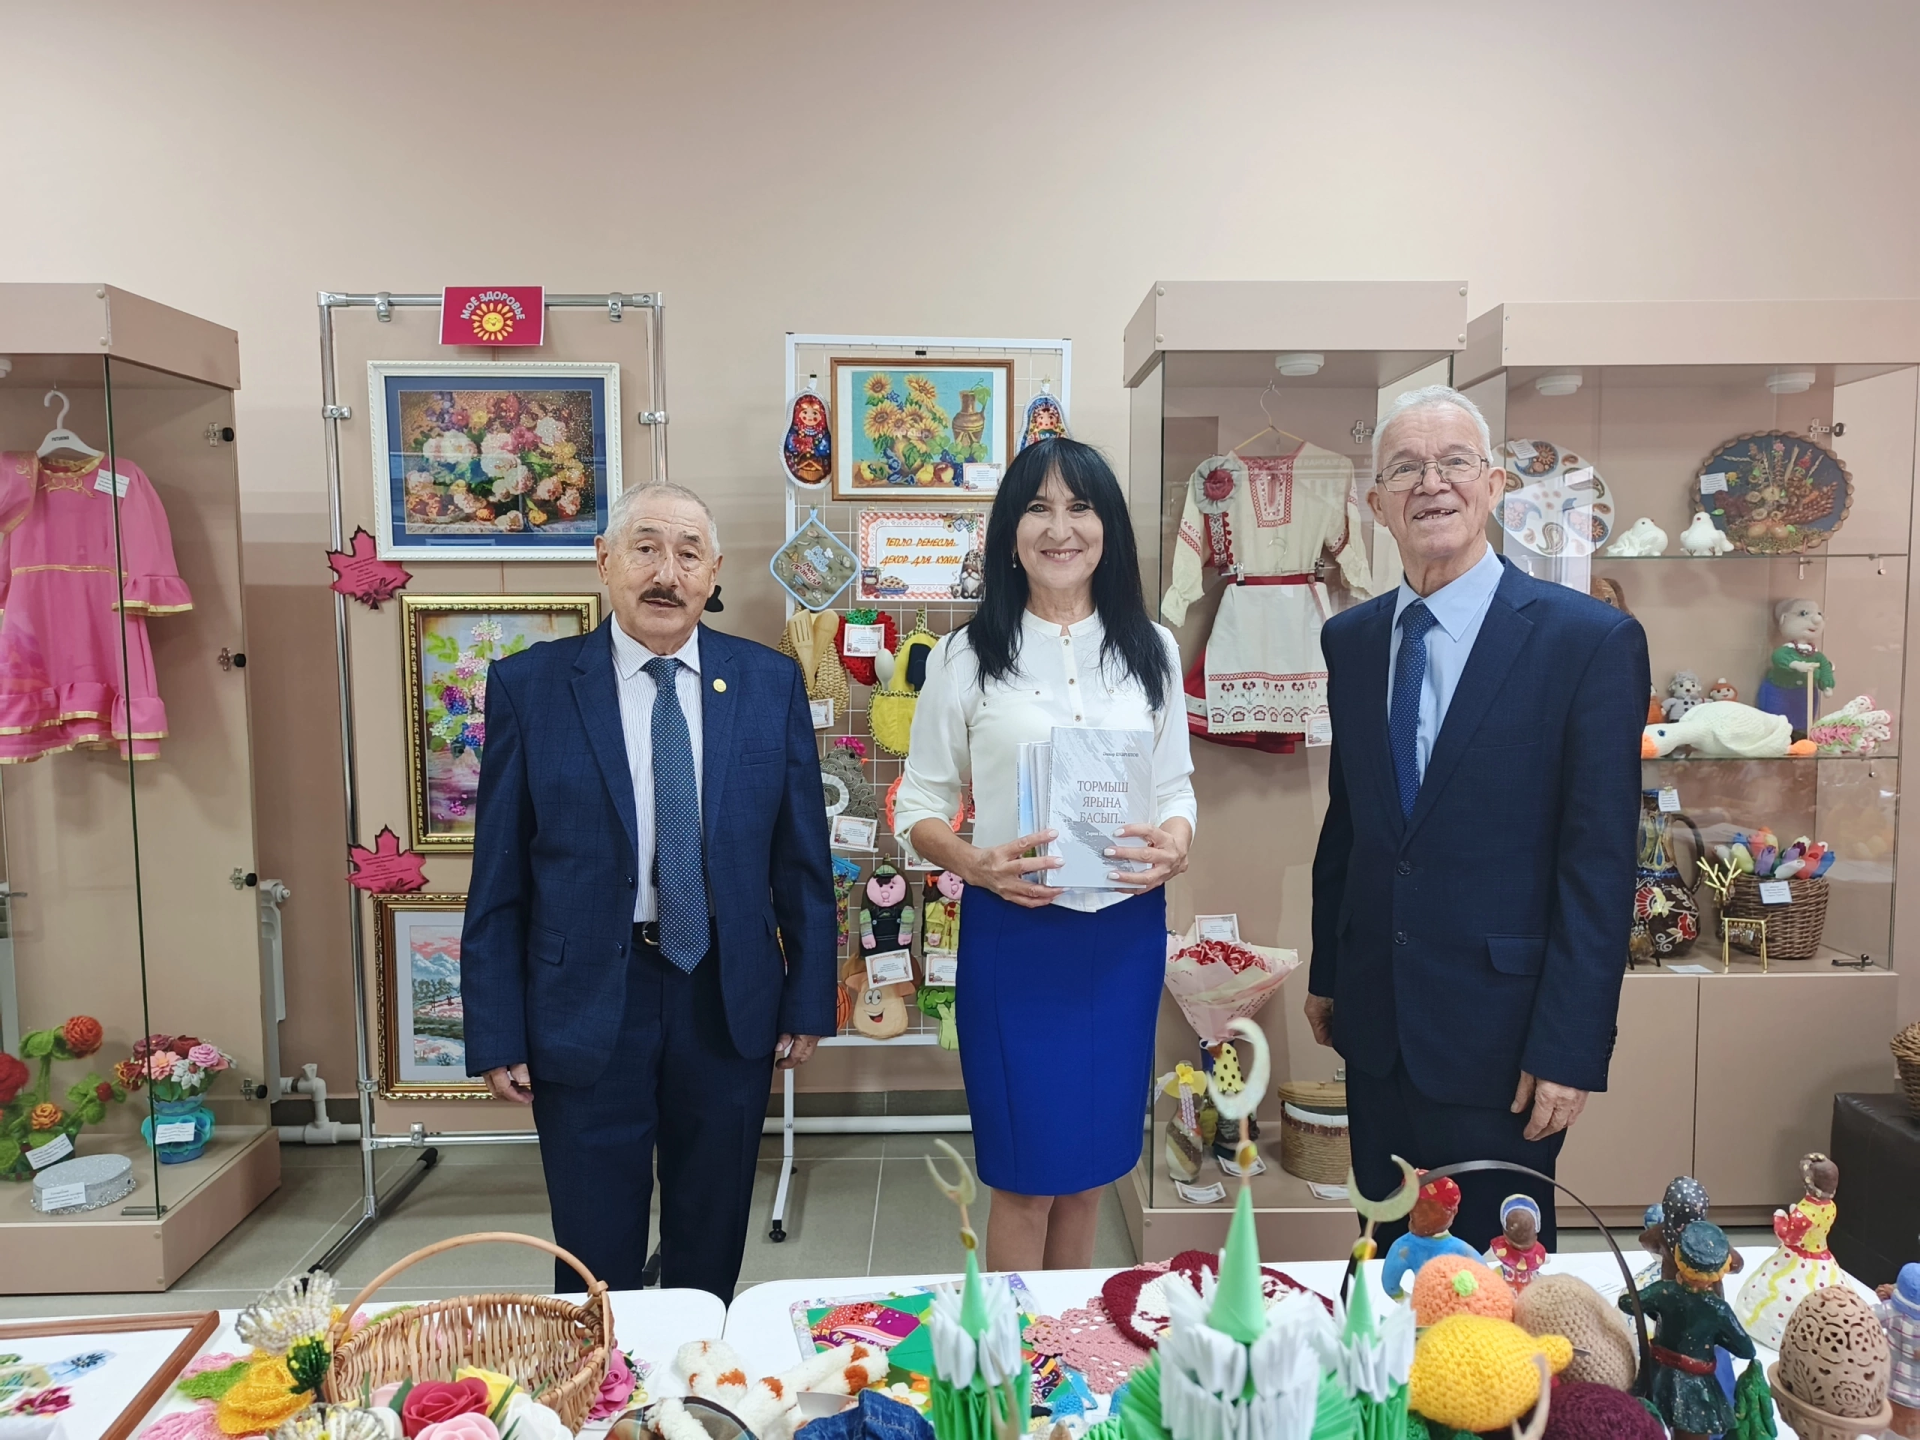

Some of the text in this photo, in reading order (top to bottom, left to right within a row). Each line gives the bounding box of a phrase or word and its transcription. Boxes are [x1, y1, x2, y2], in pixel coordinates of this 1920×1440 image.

[460, 291, 526, 320] МОЕ ЗДОРОВЬЕ
[885, 537, 913, 547] ТЕПЛО
[880, 555, 962, 567] ДЕКОР ДЛЯ КУХНИ
[1077, 780, 1129, 793] ТОРМЫШ
[1082, 796, 1122, 808] ЯРЫНА
[1079, 811, 1126, 824] БАСЫП...
